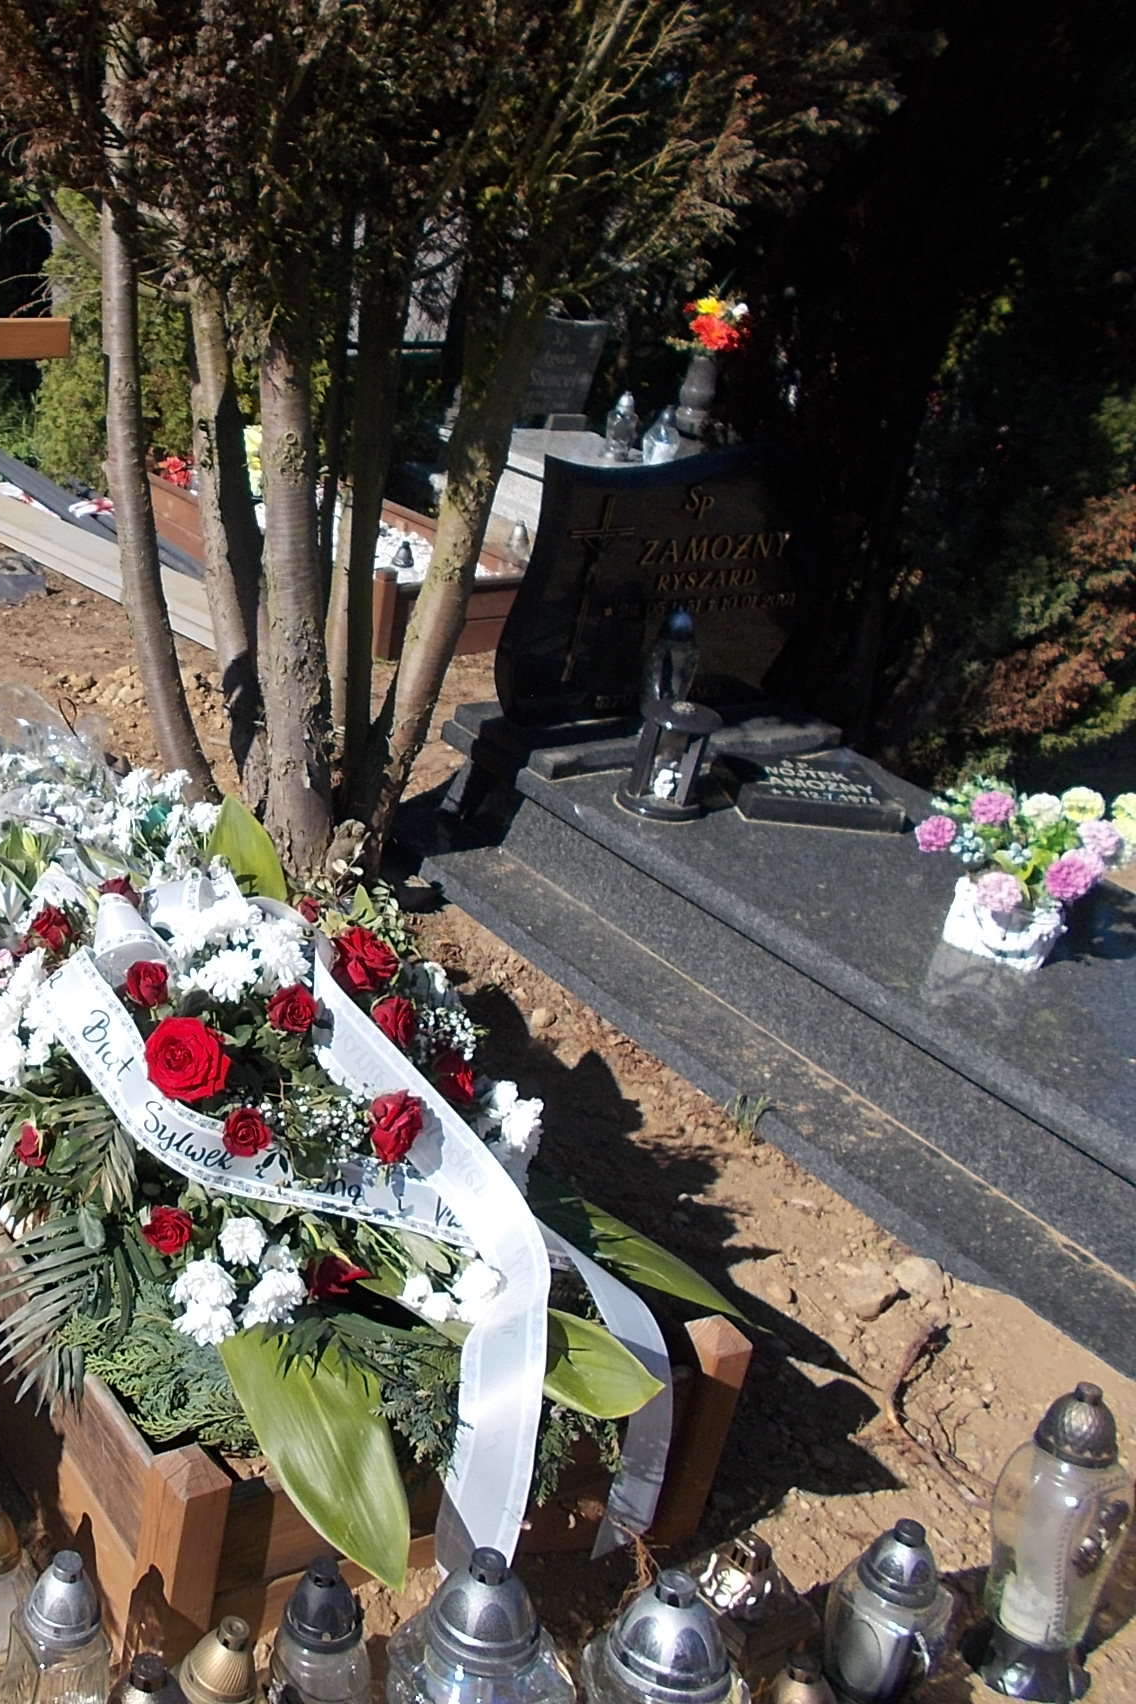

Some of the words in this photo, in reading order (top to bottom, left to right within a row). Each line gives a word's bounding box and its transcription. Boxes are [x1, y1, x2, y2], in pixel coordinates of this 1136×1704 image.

[655, 568, 758, 592] RYSZARD
[81, 1009, 136, 1083] Brat
[143, 1100, 235, 1171] Sylwek
